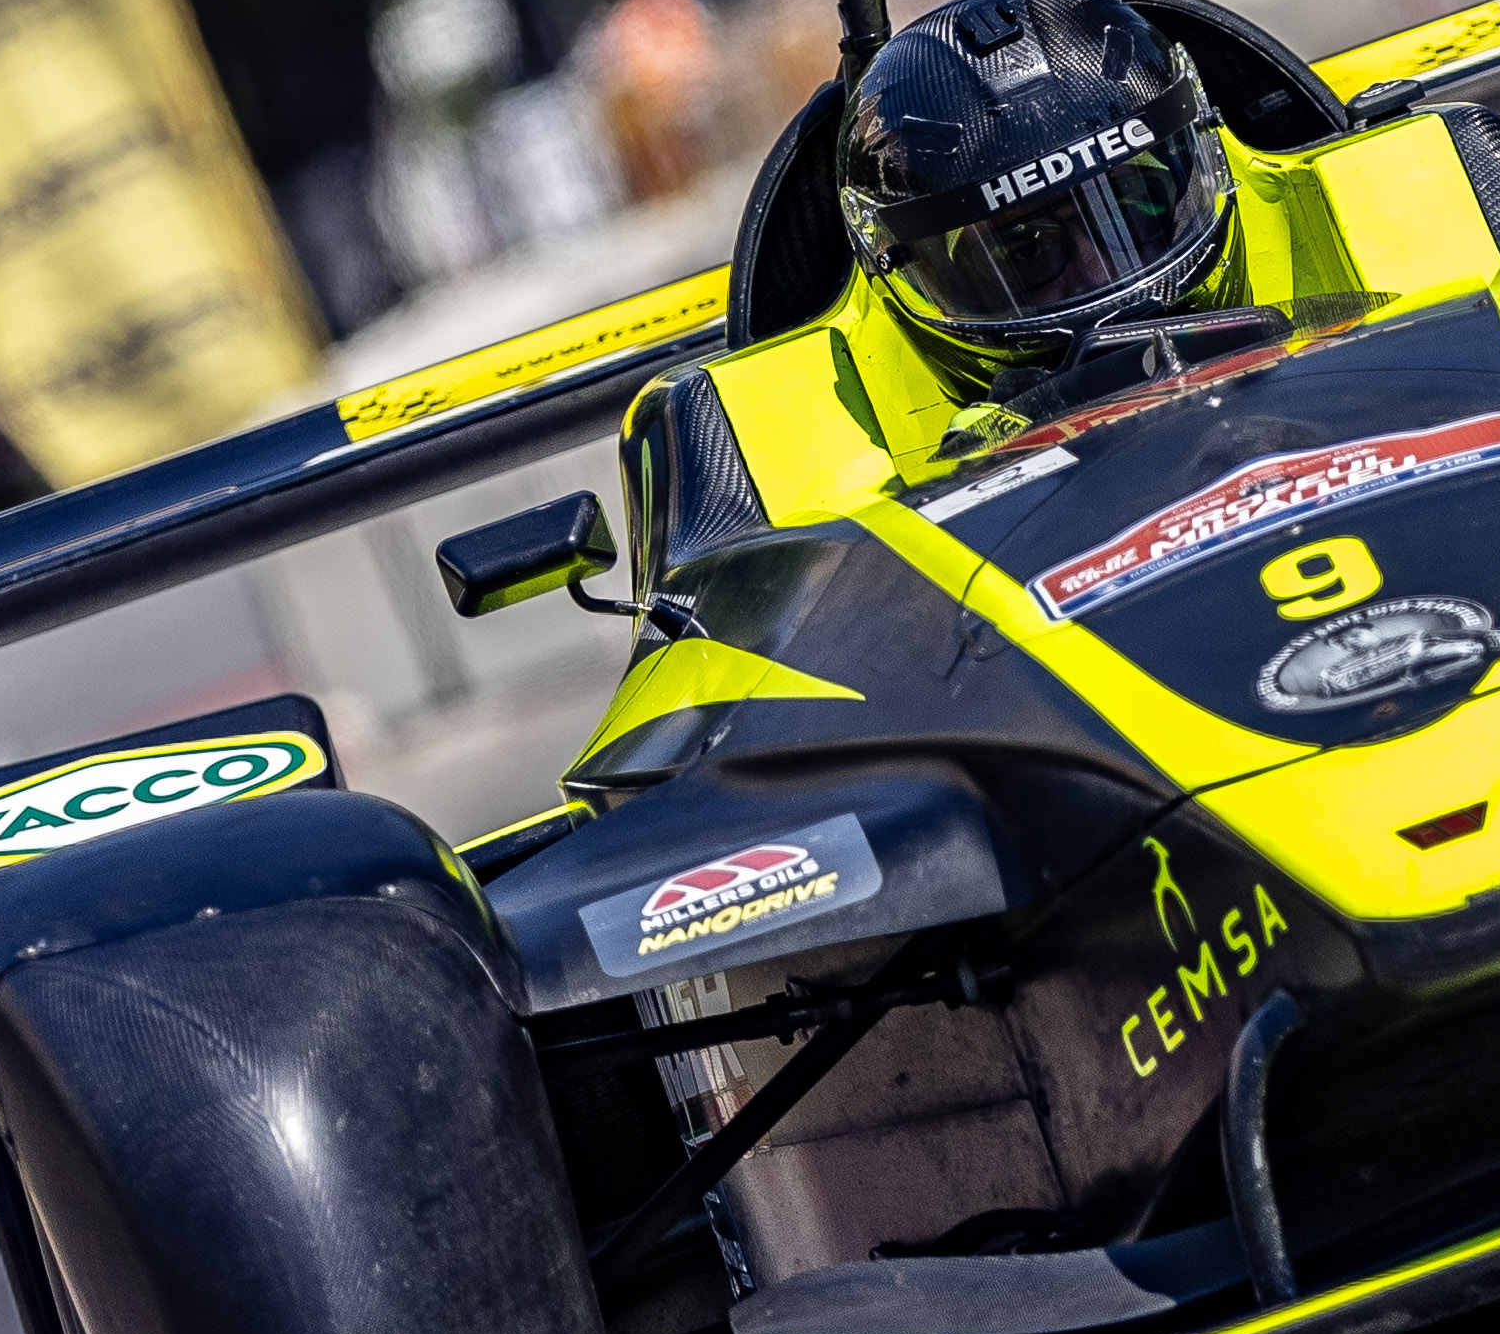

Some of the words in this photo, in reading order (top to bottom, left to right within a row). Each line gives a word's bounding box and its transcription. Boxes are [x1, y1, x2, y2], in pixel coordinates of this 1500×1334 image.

[980, 118, 1156, 212] HEDTEC
[1158, 455, 1394, 537] TROFEUL
[1331, 474, 1399, 501] UniCredit
[1261, 535, 1384, 620] 9
[638, 871, 839, 955] NANODRIVE
[640, 882, 754, 933] MILLERS
[760, 857, 819, 891] OILS
[1122, 884, 1288, 1077] CEMSA
